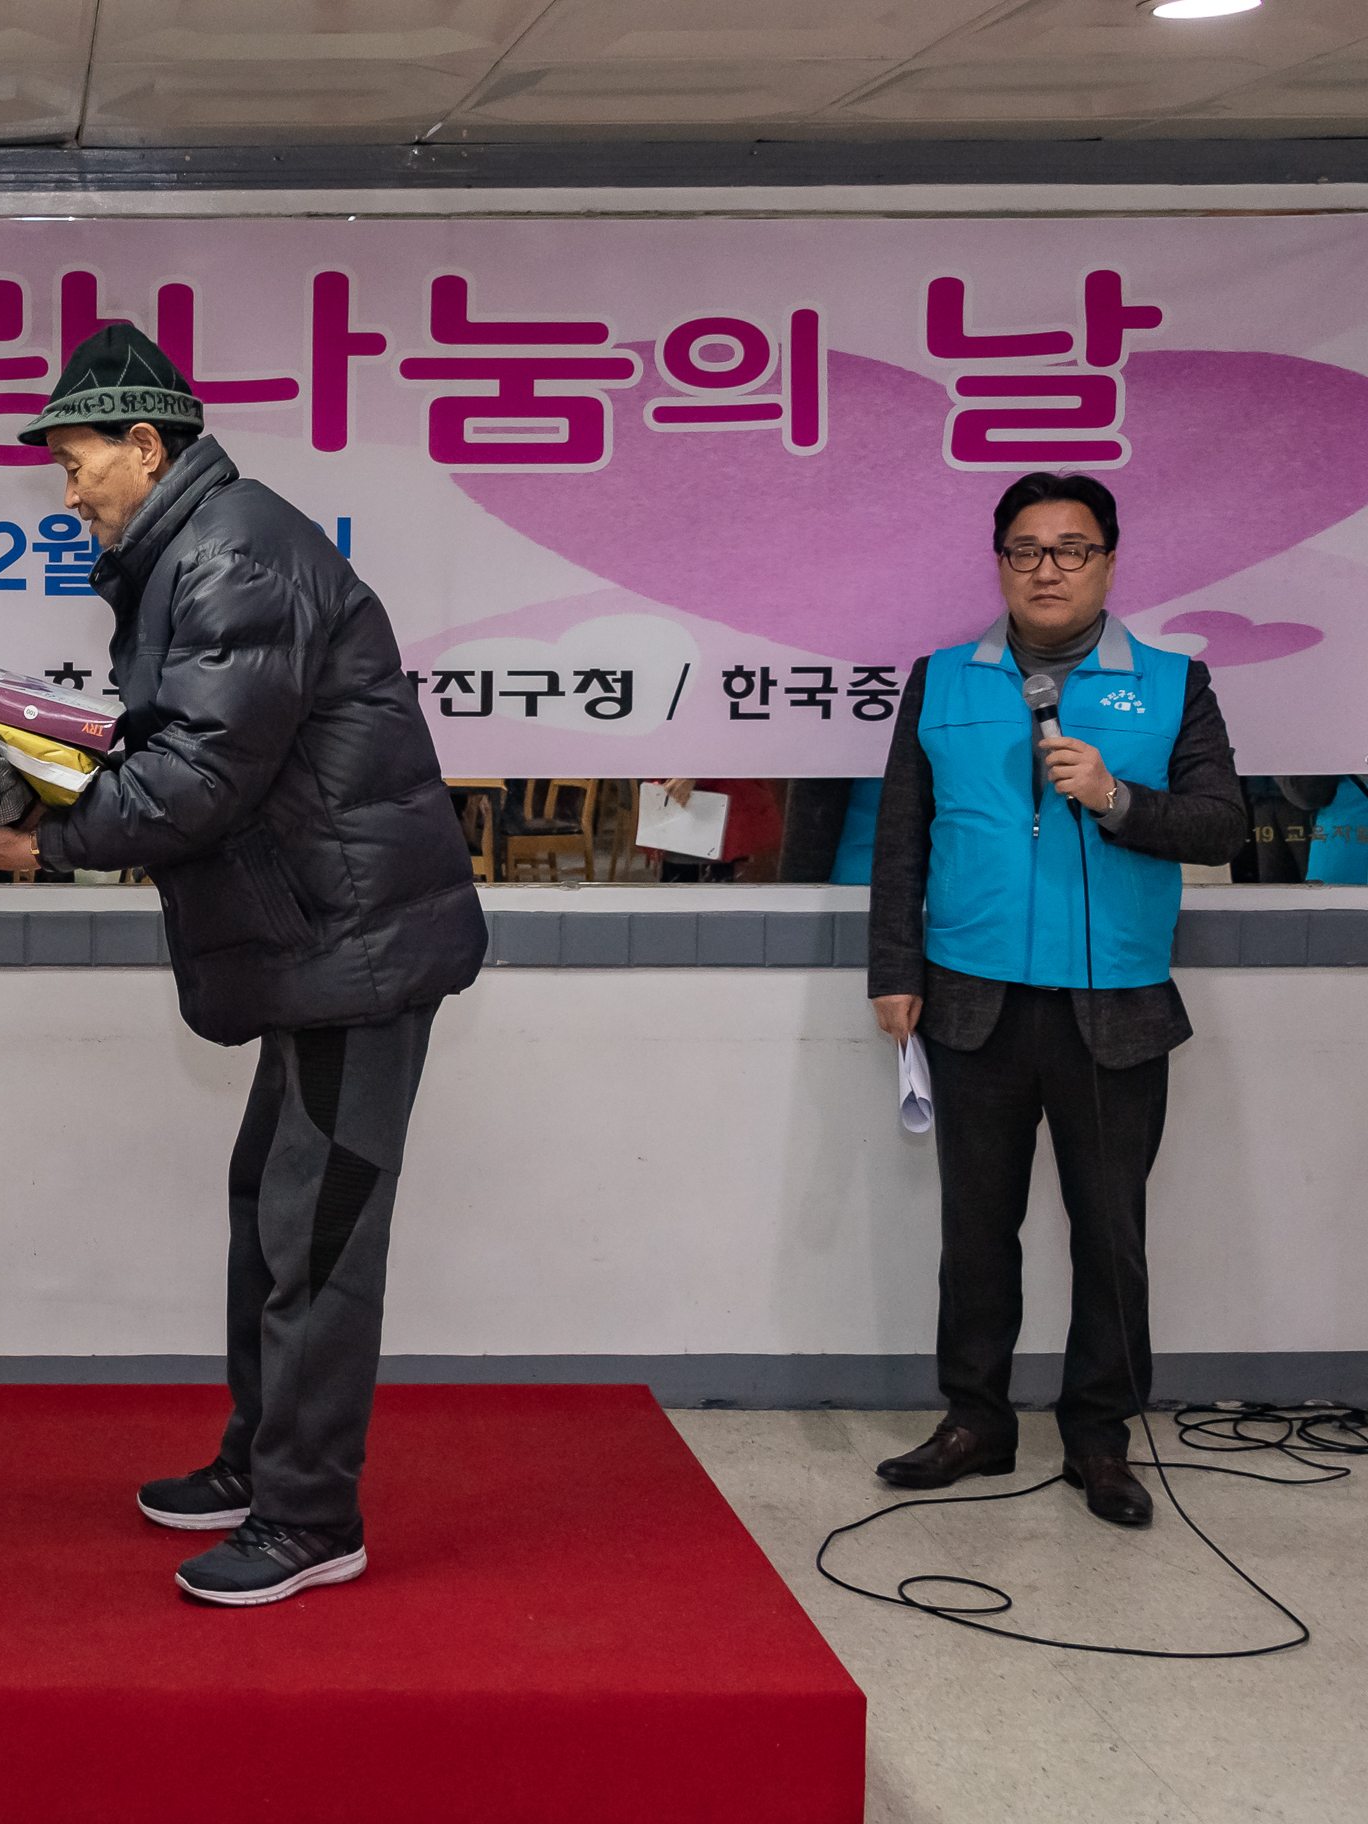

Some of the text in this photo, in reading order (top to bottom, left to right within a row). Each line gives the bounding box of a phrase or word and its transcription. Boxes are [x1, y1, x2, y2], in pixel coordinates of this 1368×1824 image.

[927, 270, 1162, 463] 날
[722, 665, 900, 720] 한국중
[81, 722, 103, 737] TRY
